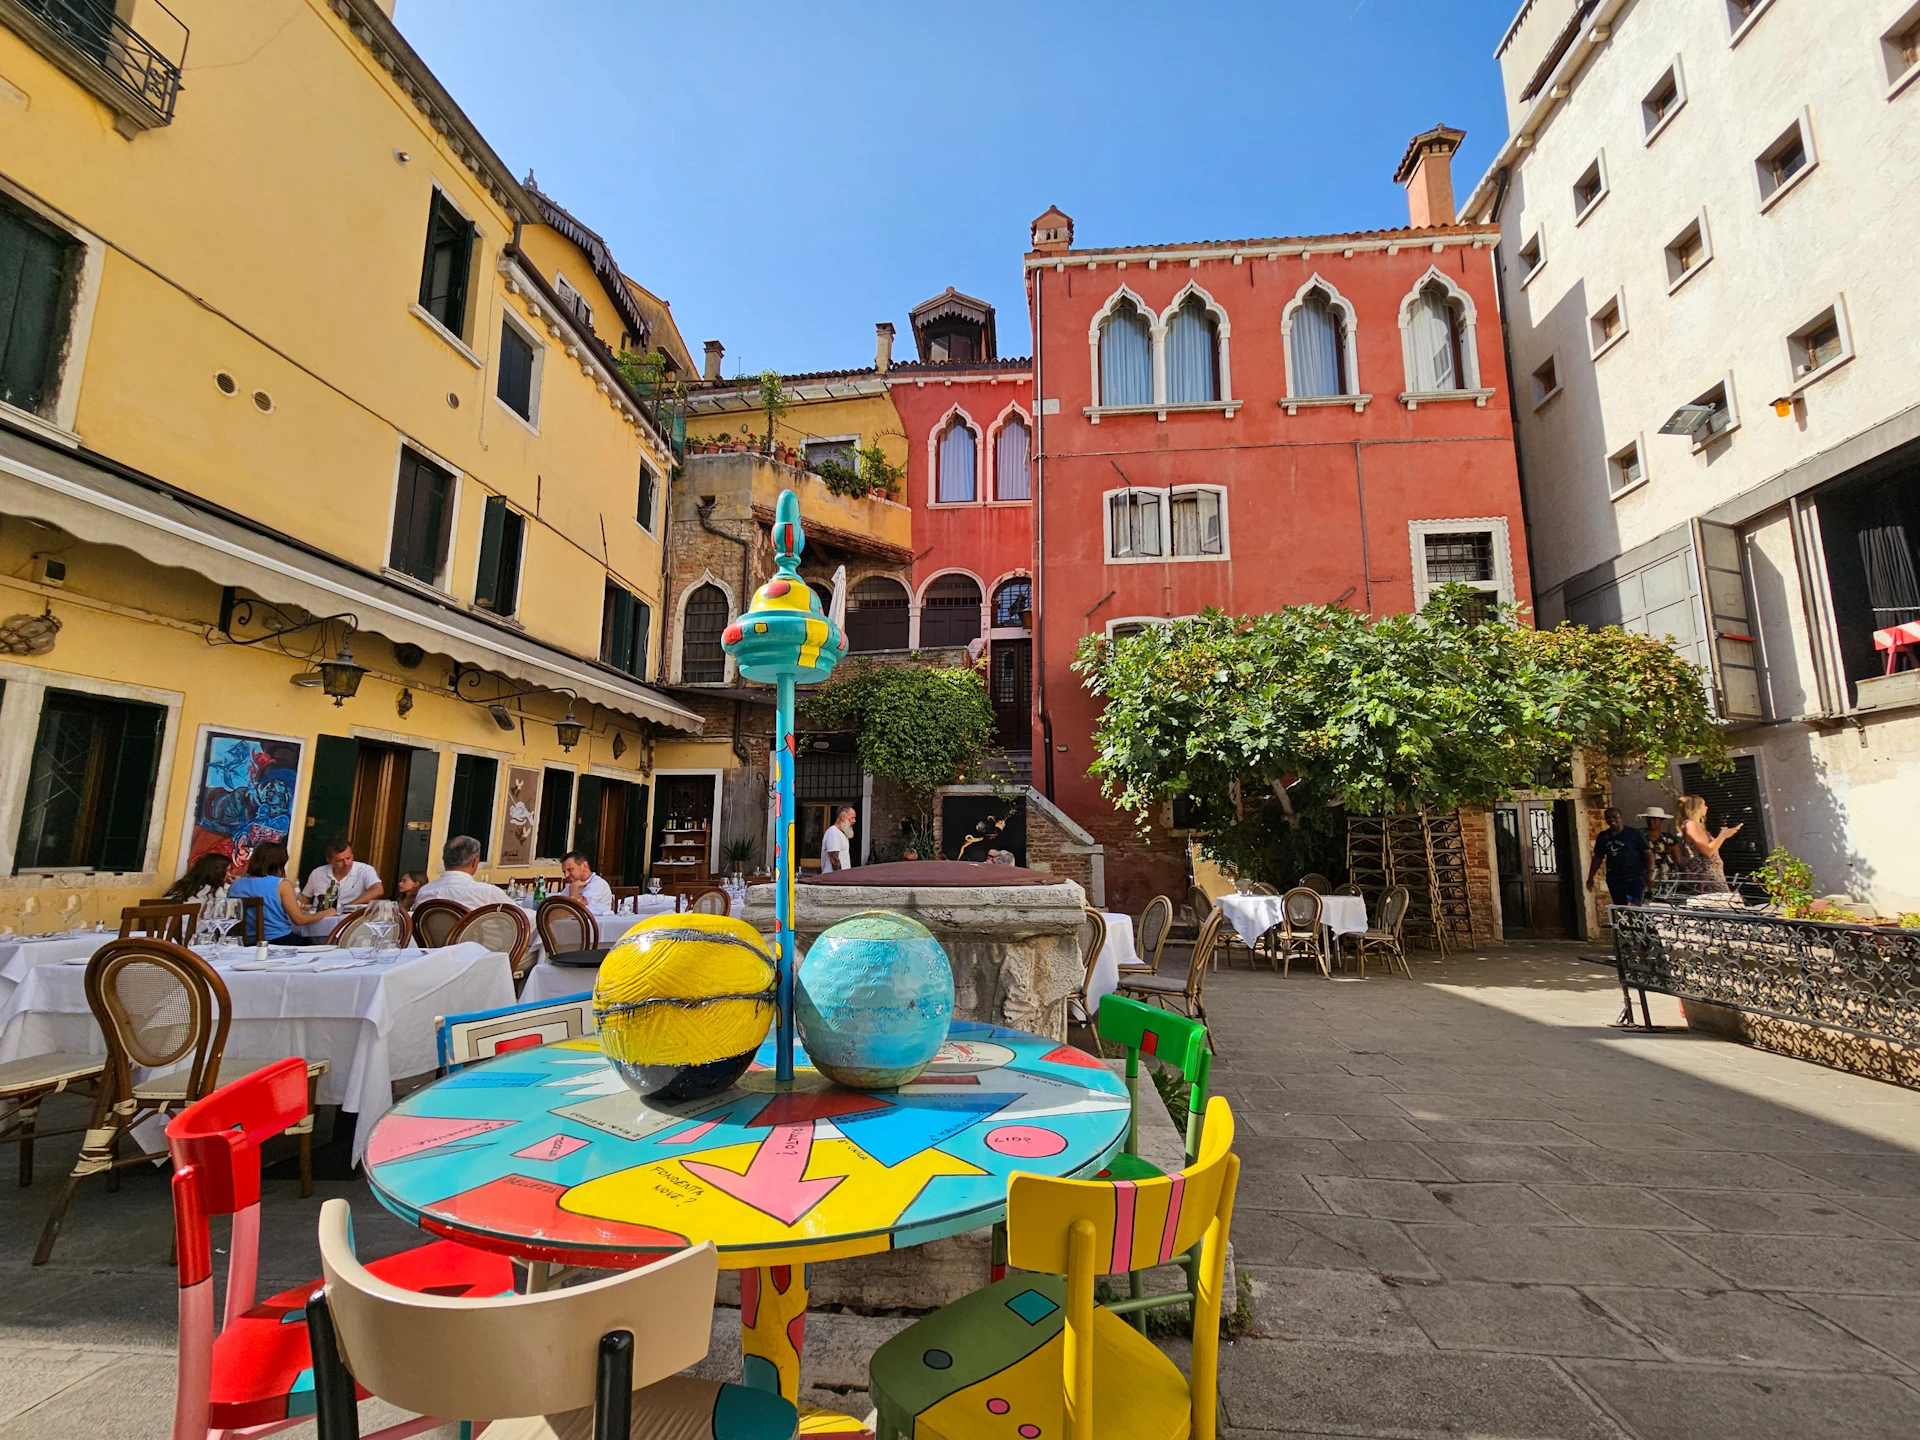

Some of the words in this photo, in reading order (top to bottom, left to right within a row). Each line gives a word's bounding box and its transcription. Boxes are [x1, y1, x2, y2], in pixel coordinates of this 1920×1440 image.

[1016, 1074, 1062, 1088] BURANO
[847, 1144, 868, 1161] UNICA
[649, 1166, 705, 1196] FONDENTA
[651, 1184, 685, 1201] NOVE
